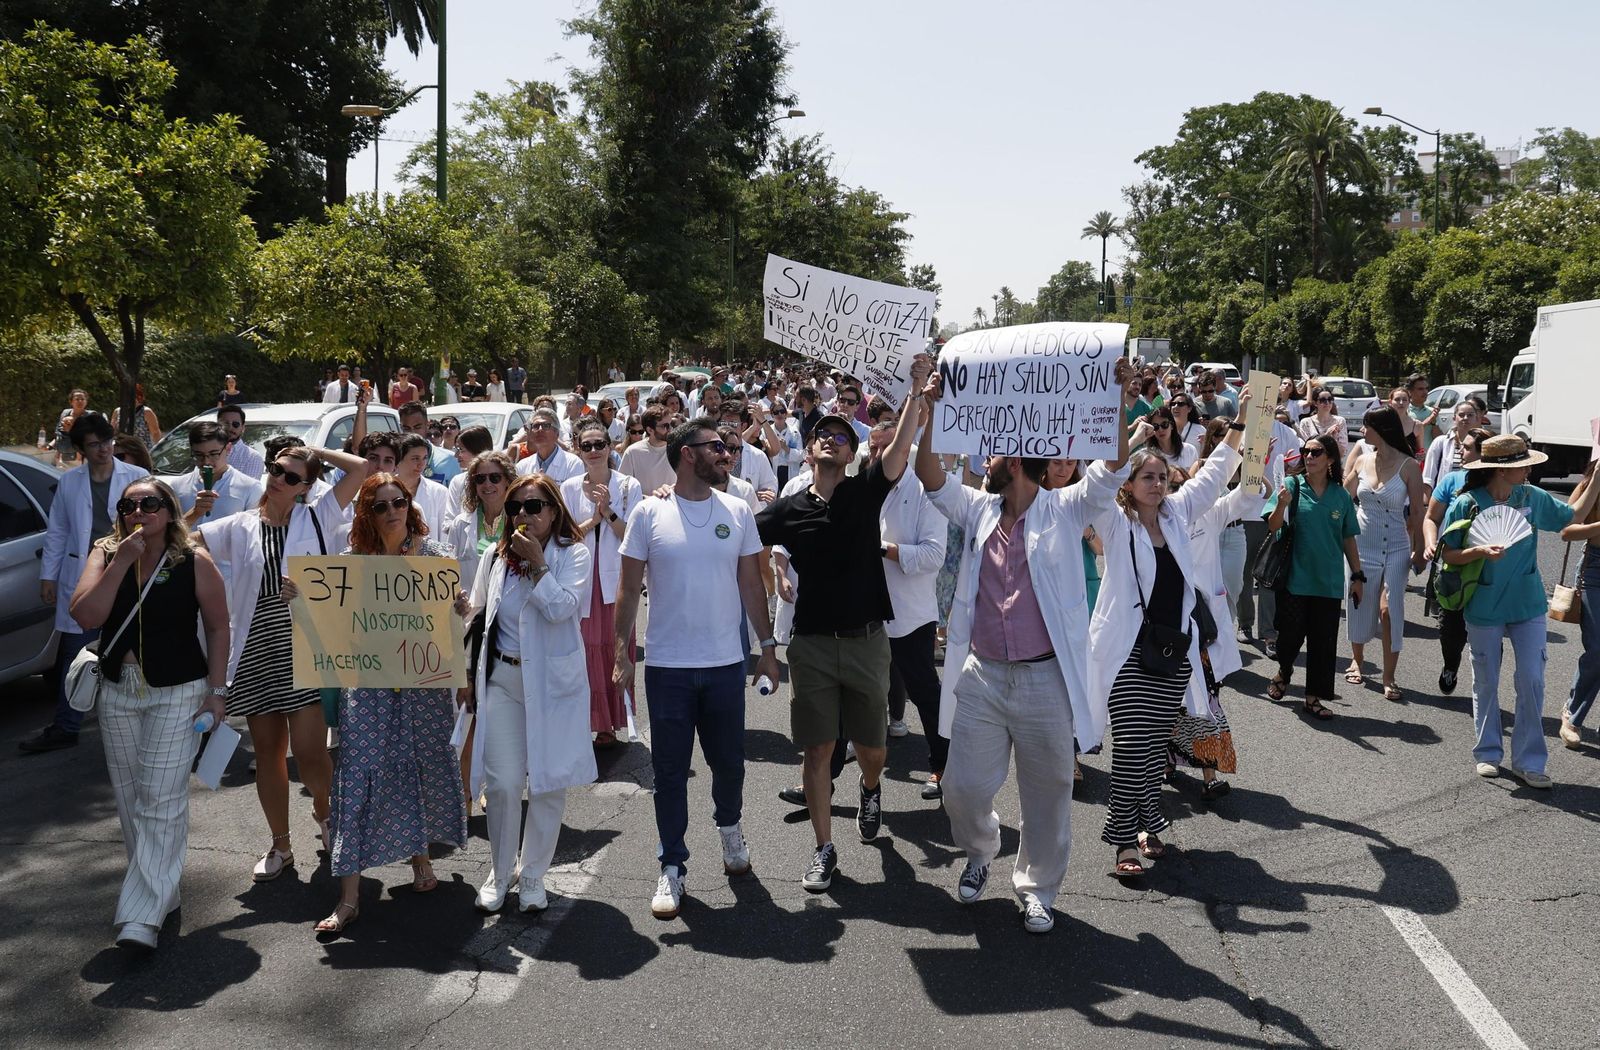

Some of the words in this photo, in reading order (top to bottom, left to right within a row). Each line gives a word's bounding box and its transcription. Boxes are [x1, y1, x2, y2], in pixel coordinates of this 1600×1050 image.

[825, 285, 860, 316] NO
[808, 311, 839, 333] NO
[883, 355, 905, 384] EL
[939, 356, 968, 399] NO
[976, 361, 1008, 396] HAY
[1012, 361, 1072, 399] SALUD,
[942, 402, 1016, 437] DERECHOS
[1018, 402, 1041, 437] NO
[1046, 402, 1076, 437] HAY
[1081, 427, 1091, 435] NO
[303, 565, 354, 607] 37
[352, 607, 435, 634] NOSOTROS
[313, 653, 383, 672] HACEMOS
[396, 639, 442, 676] 100
